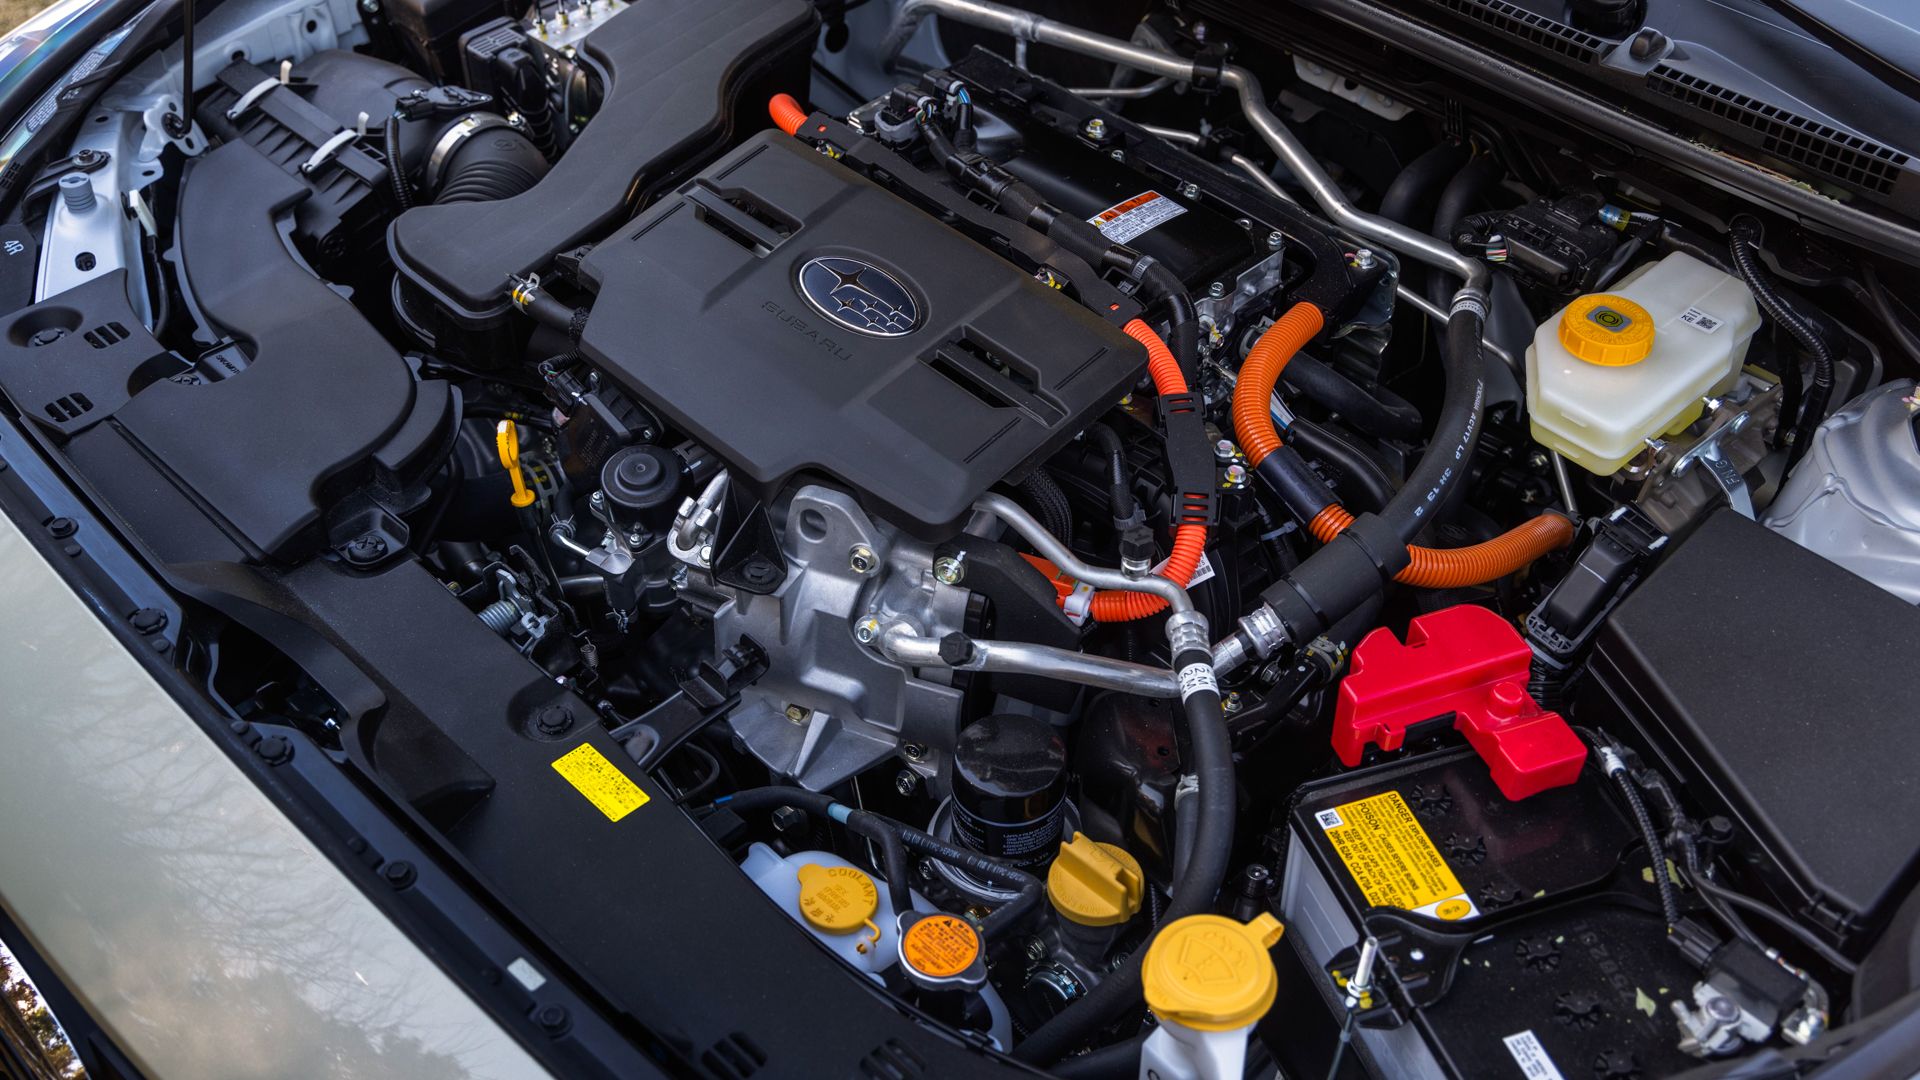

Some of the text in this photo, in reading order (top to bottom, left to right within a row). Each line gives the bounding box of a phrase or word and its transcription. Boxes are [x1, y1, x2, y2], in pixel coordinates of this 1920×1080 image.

[4, 240, 24, 256] 4R
[761, 301, 853, 361] SUBARU
[1427, 487, 1440, 502] 13
[1414, 506, 1424, 516] 2
[1343, 830, 1354, 843] KEEP
[1388, 793, 1441, 867] DANGER EXPLOSIVE GASES
[1358, 802, 1380, 830] POISON
[1379, 833, 1395, 852] CAUSES
[1392, 853, 1407, 871] SEVERE
[1404, 872, 1419, 889] BURNS
[1350, 828, 1362, 841] KEEP
[1367, 854, 1379, 867] CAPS
[1386, 883, 1396, 893] AND
[1350, 862, 1364, 875] CCA
[828, 868, 874, 906] COOLANT
